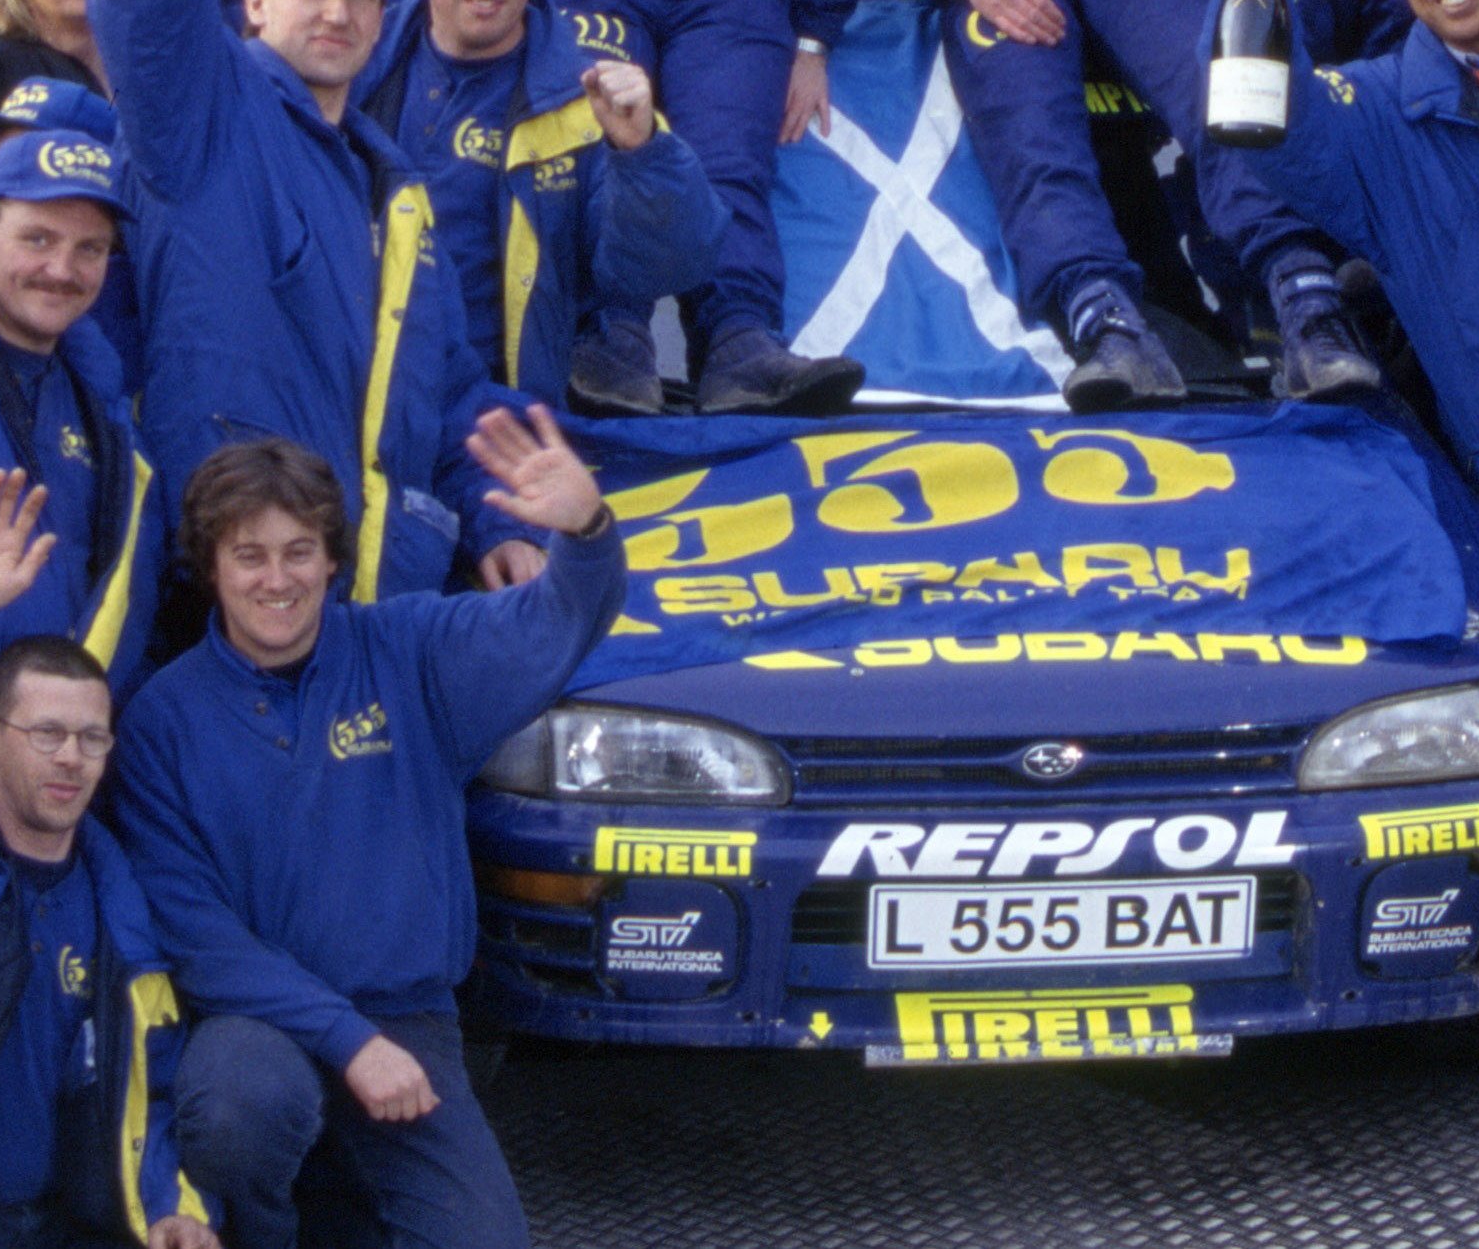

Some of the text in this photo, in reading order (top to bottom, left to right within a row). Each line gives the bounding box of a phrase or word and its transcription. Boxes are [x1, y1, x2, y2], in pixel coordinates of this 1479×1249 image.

[53, 144, 112, 168] 555
[335, 701, 387, 746] 555
[594, 825, 758, 877] PIRELLI
[816, 810, 1297, 876] REPSOL
[885, 890, 1242, 954] L 555 BAT
[1366, 937, 1470, 955] INTERNATIONAL
[608, 960, 723, 973] INTERNATIONAL
[894, 983, 1200, 1061] PIRELLI
